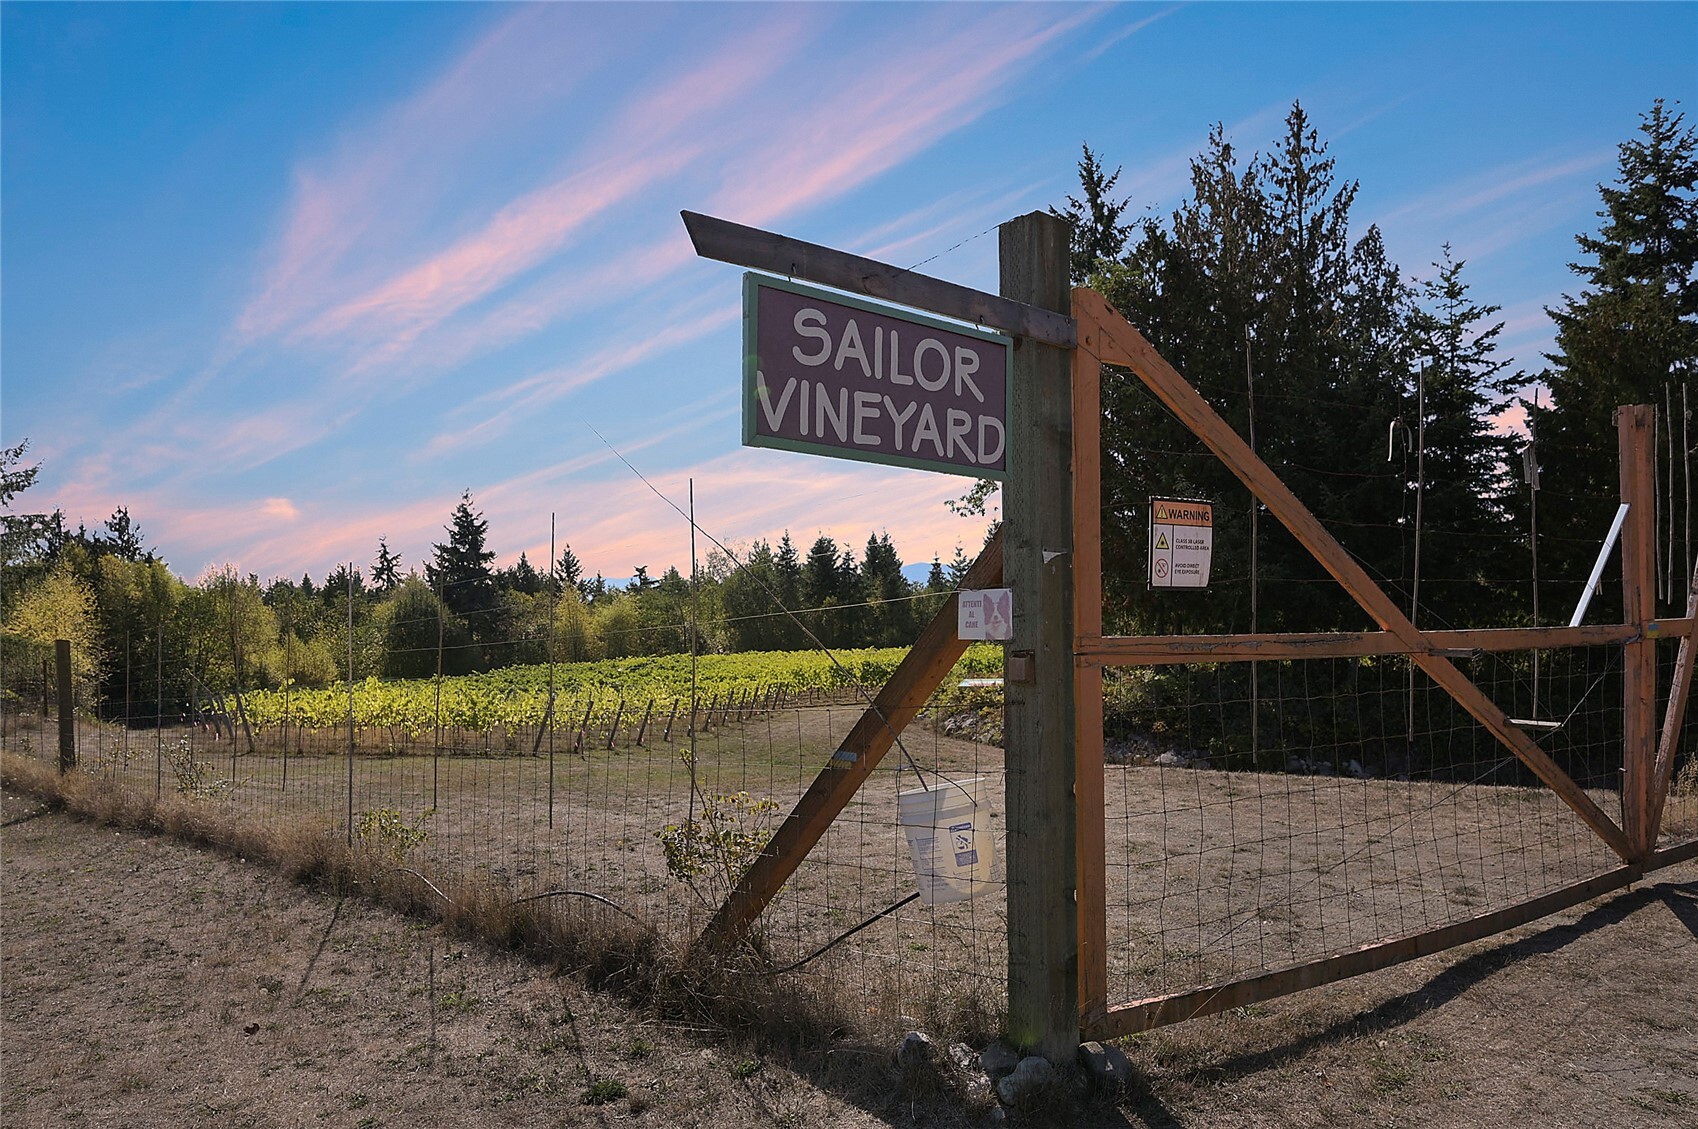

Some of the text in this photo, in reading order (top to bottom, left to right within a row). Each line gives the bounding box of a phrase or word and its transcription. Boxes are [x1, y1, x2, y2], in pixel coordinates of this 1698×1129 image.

[792, 308, 985, 403] SAILOR
[757, 370, 1006, 464] VINEYARD
[1168, 509, 1210, 522] WARNING
